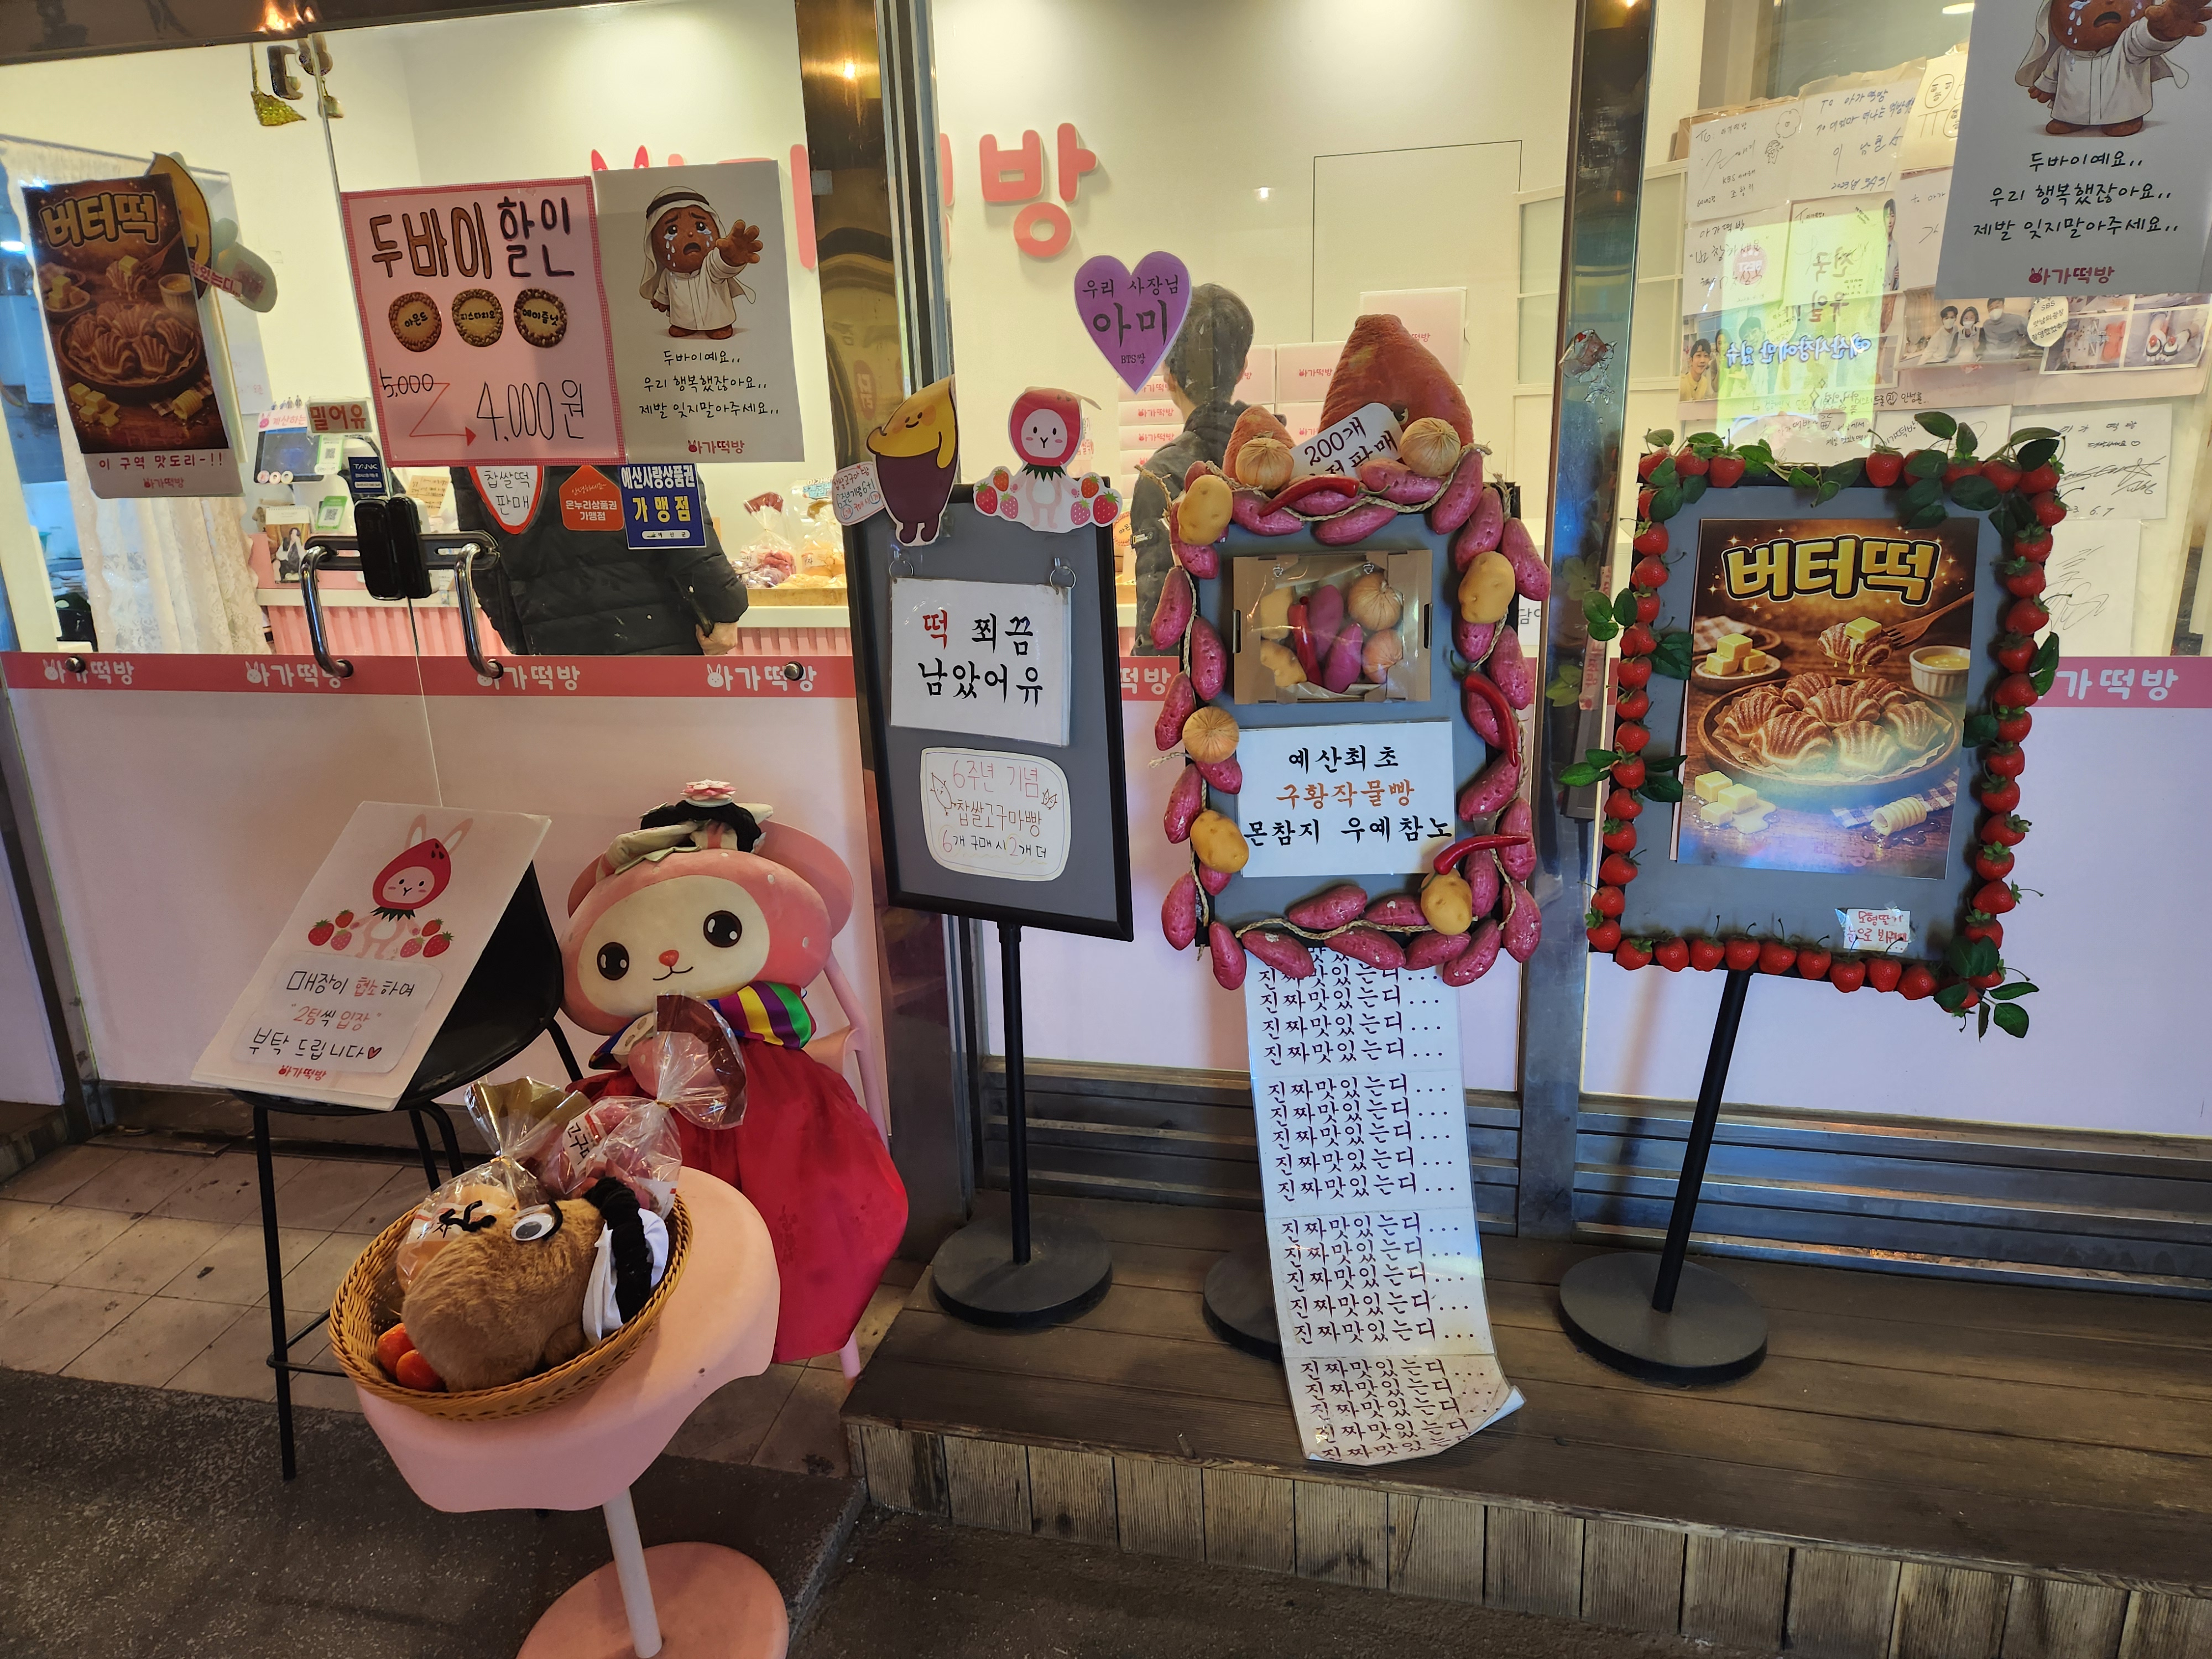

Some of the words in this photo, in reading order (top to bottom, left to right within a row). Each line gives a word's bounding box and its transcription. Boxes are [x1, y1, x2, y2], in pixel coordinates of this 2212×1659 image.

[1989, 186, 2026, 207] 우리
[39, 193, 160, 247] 버터떡
[1973, 220, 2016, 241] 제발
[369, 202, 493, 279] 두바이
[497, 197, 576, 278] 할인
[1082, 278, 1115, 299] 우리
[1126, 274, 1180, 297] 사장님
[2028, 265, 2116, 286] 아가떡방
[460, 310, 496, 321] 피스타치오
[521, 308, 560, 326] 헤이즐넛
[2041, 300, 2056, 311] SBS
[1092, 299, 1168, 348] 아미
[379, 368, 434, 398] 5,000
[644, 376, 667, 394] 우리
[1298, 367, 1333, 378] 아가떡방
[310, 404, 367, 431] 밀어유
[638, 401, 667, 420] 제발
[1138, 407, 1174, 417] 아가떡방
[688, 437, 745, 455] 아가떡방
[1138, 432, 1175, 442] 아가떡방
[1304, 416, 1367, 467] 200개
[99, 460, 110, 471] 이
[119, 455, 147, 470] 구역
[143, 476, 185, 489] 아가떡방
[483, 469, 530, 490] 찹쌀떡
[620, 465, 696, 490] 예산사랑상품권
[497, 494, 530, 515] 판매
[565, 499, 618, 510] 온누리상품권
[580, 511, 606, 521] 가맹점
[632, 495, 691, 523] 가맹점
[1723, 535, 1940, 606] 버터떡
[922, 609, 948, 650] 떡
[917, 657, 1044, 708] 남았어유
[1120, 667, 1171, 695] 떡방
[2056, 668, 2179, 701] 가떡방
[1288, 744, 1400, 775] 예산최초
[952, 760, 994, 793] 6주년
[1006, 765, 1040, 799] 기념
[1276, 779, 1416, 810] 구황작물빵
[957, 799, 1043, 838] 찹쌀고구마빵
[942, 829, 966, 853] 6개
[970, 833, 992, 849] 구매
[995, 837, 1007, 851] 시
[1008, 836, 1032, 858] 2개
[1035, 844, 1047, 859] 더
[1243, 818, 1321, 848] 몬참지
[1340, 815, 1454, 844] 우예참노
[285, 970, 349, 995] 매장이
[249, 1027, 290, 1056] 부탁
[294, 1038, 366, 1061] 드립니다
[278, 1065, 327, 1082] 아가떡방
